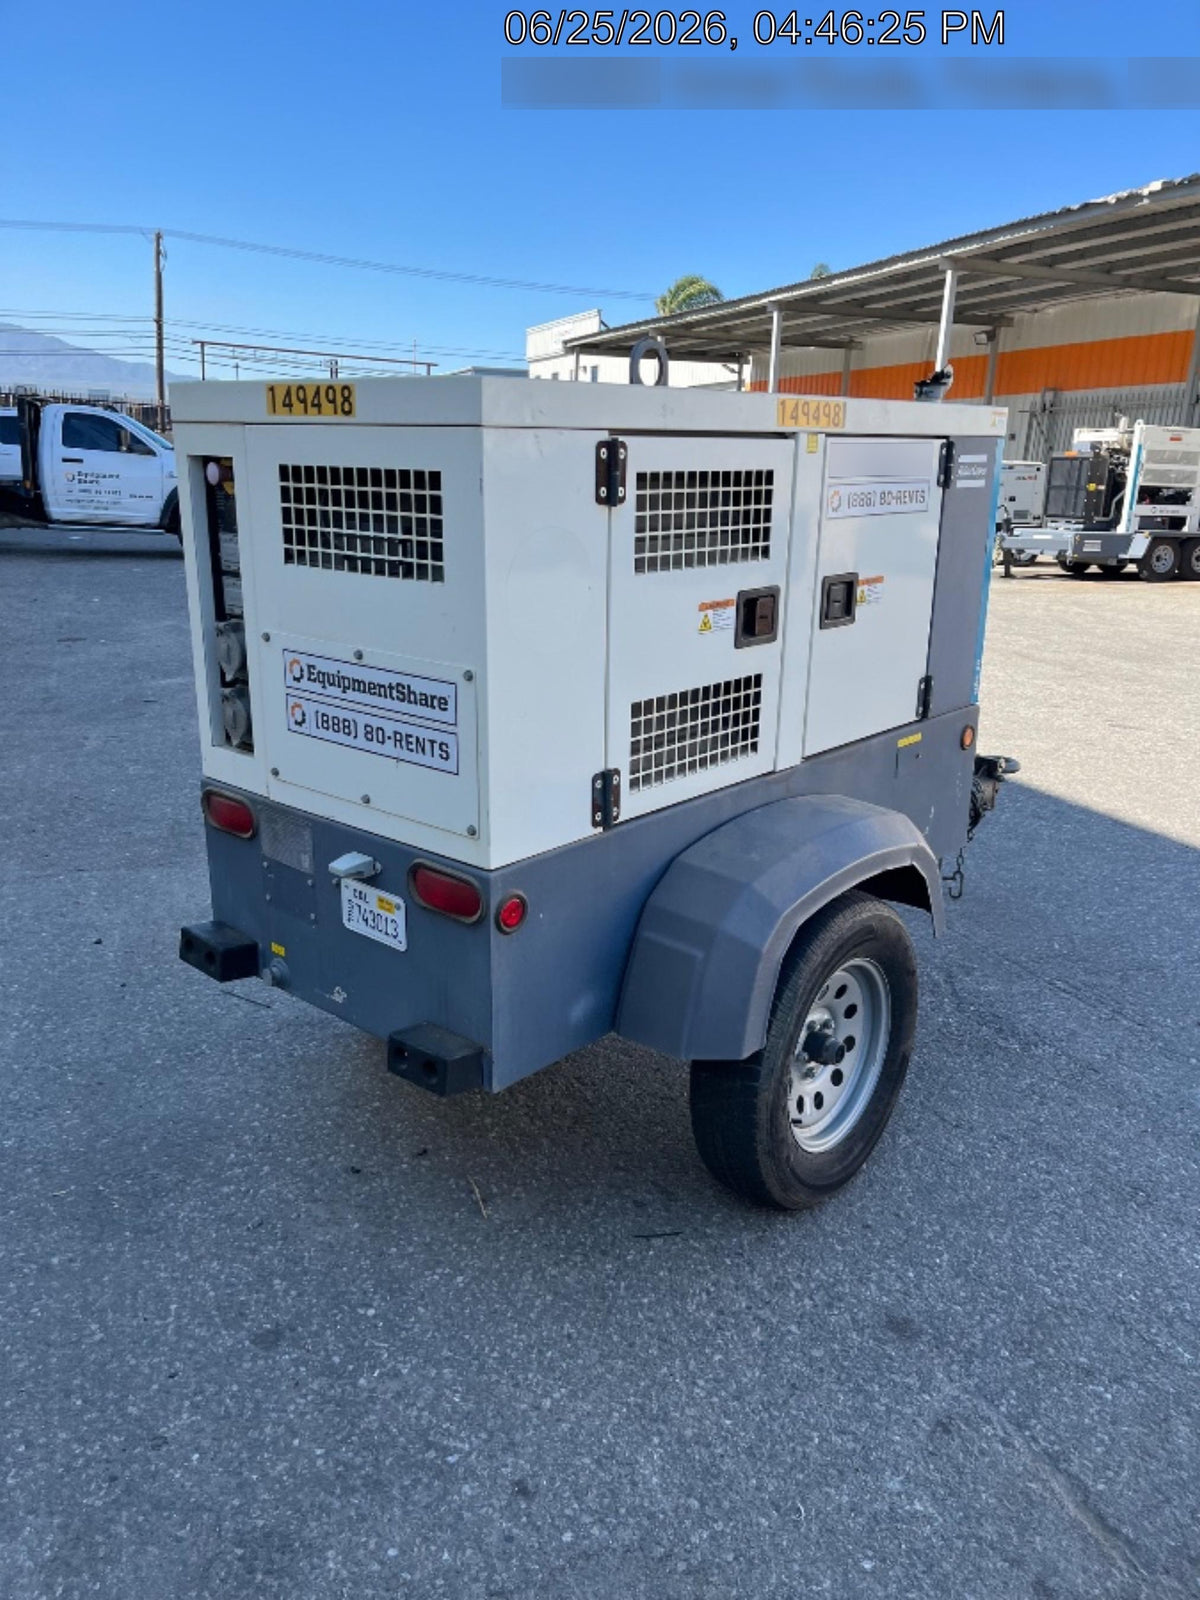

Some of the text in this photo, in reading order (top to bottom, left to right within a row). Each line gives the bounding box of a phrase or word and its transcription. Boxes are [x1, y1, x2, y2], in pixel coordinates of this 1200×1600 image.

[268, 384, 353, 416] 149498
[780, 399, 841, 428] 149498
[306, 663, 450, 712] EquipmentShare
[314, 709, 450, 762] (888) 80-RENTS
